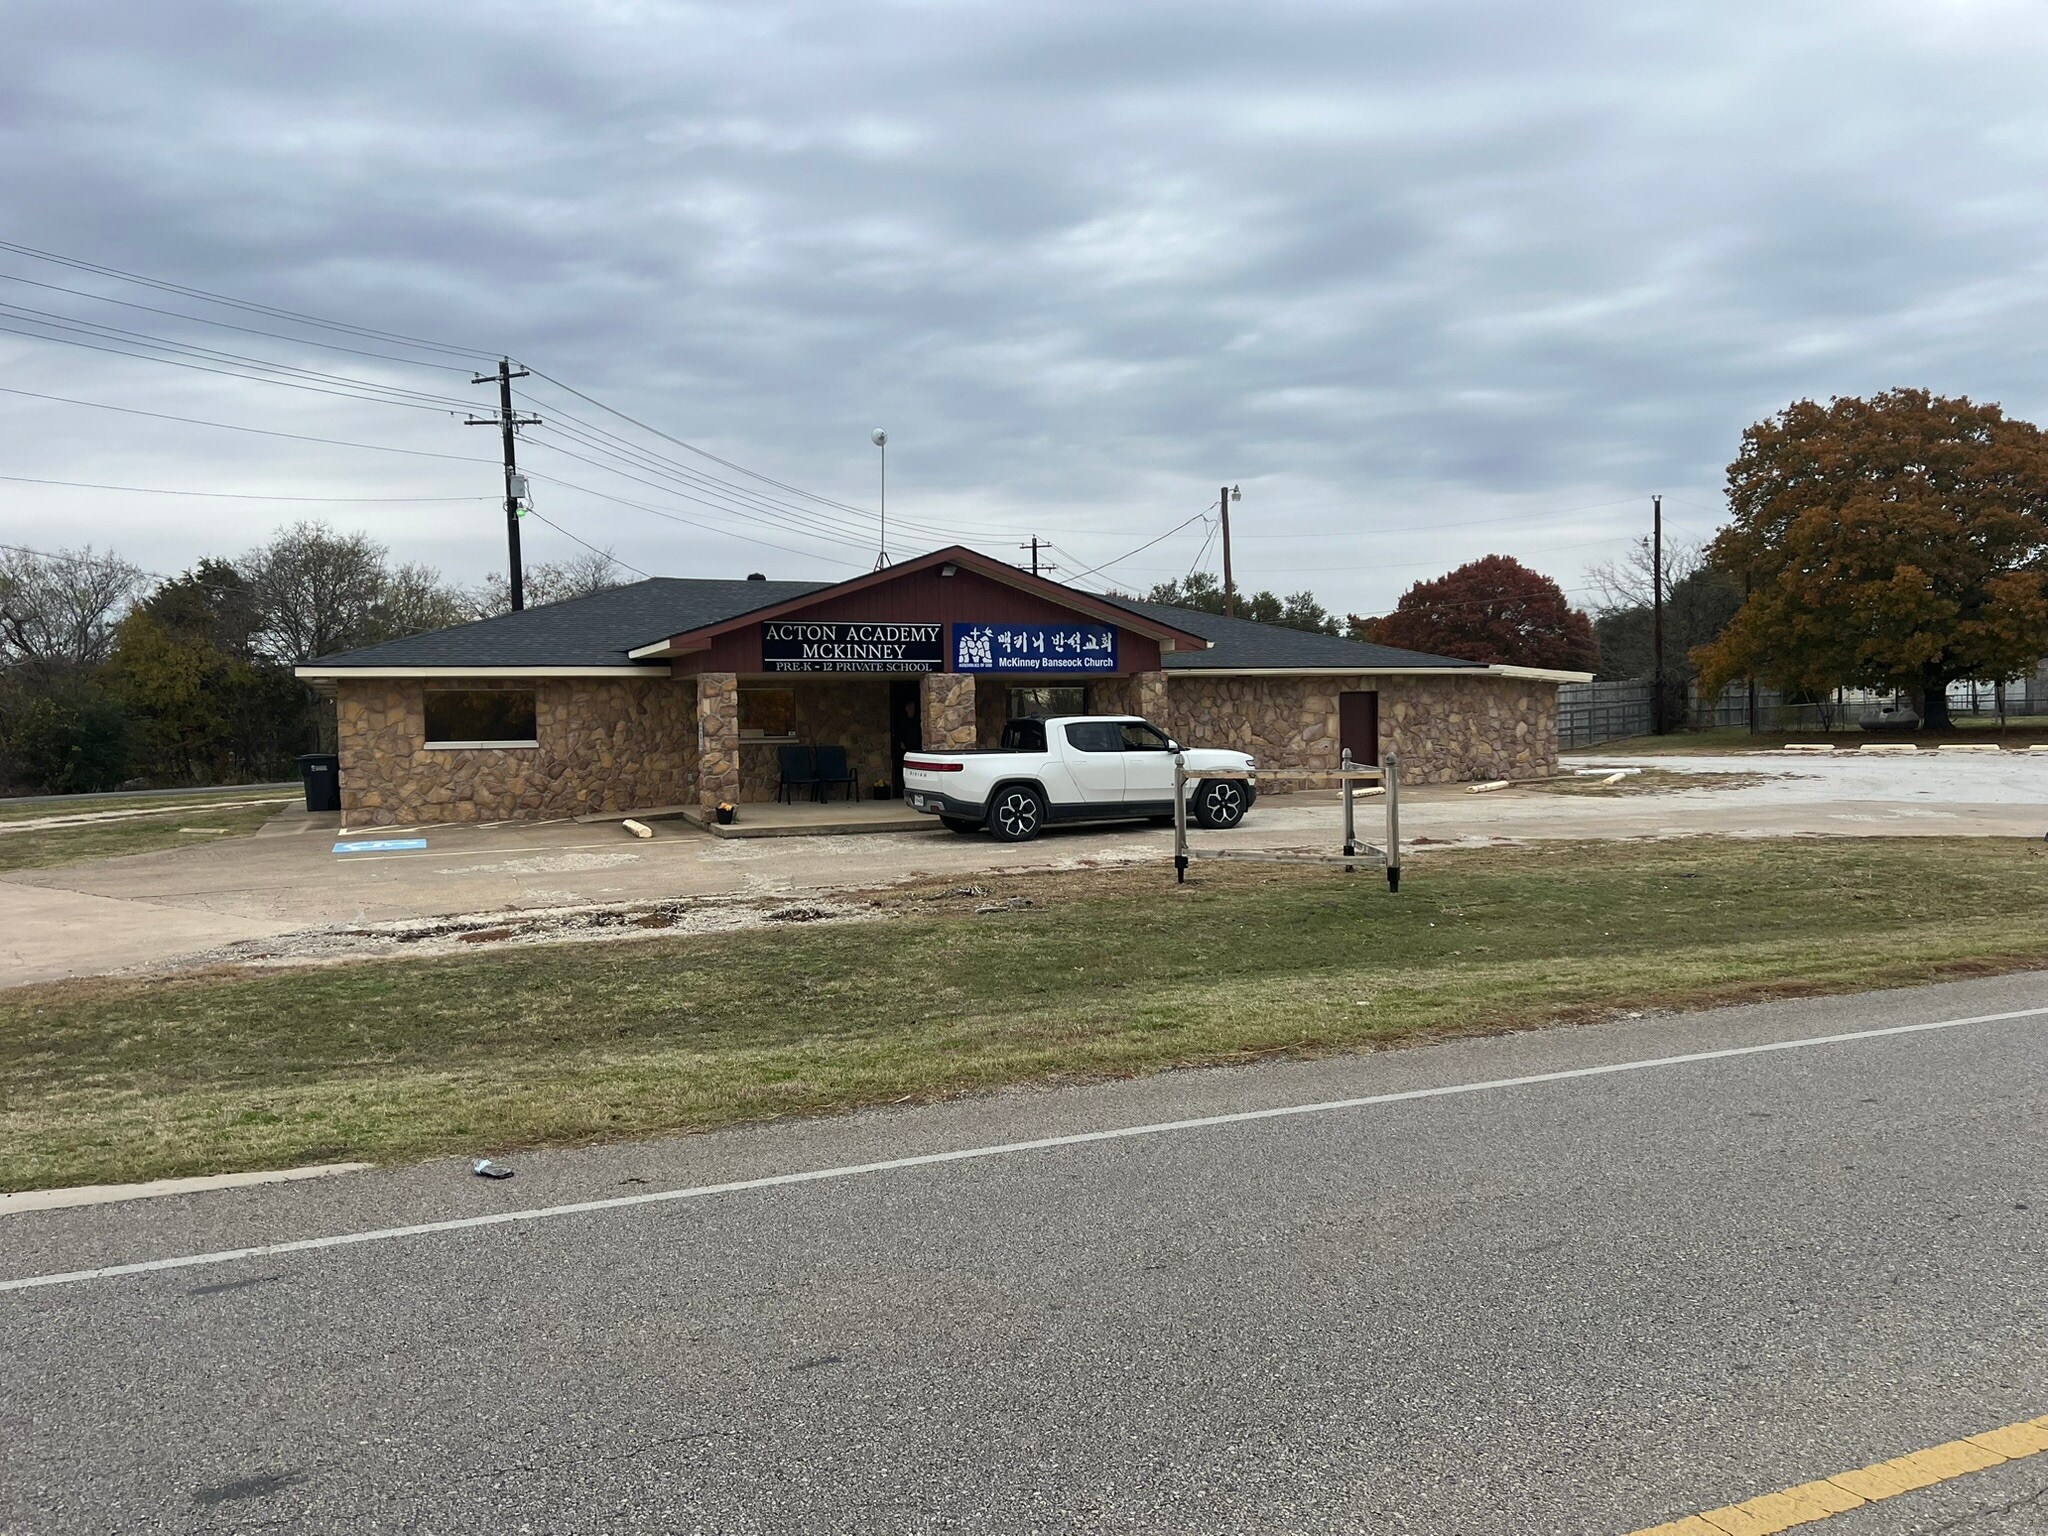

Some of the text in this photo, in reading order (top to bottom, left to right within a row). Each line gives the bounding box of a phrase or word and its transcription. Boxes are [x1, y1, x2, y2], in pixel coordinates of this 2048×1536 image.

[766, 625, 940, 642] ACTON ACADEMY
[802, 643, 906, 659] MCKINNEY
[776, 662, 812, 671] PRE-K
[823, 662, 833, 671] 12
[836, 662, 884, 672] PRIVATE
[886, 662, 932, 672] SCHOOL
[999, 657, 1040, 669] McKinney
[1042, 657, 1082, 667] Banseock
[1084, 657, 1113, 667] Church
